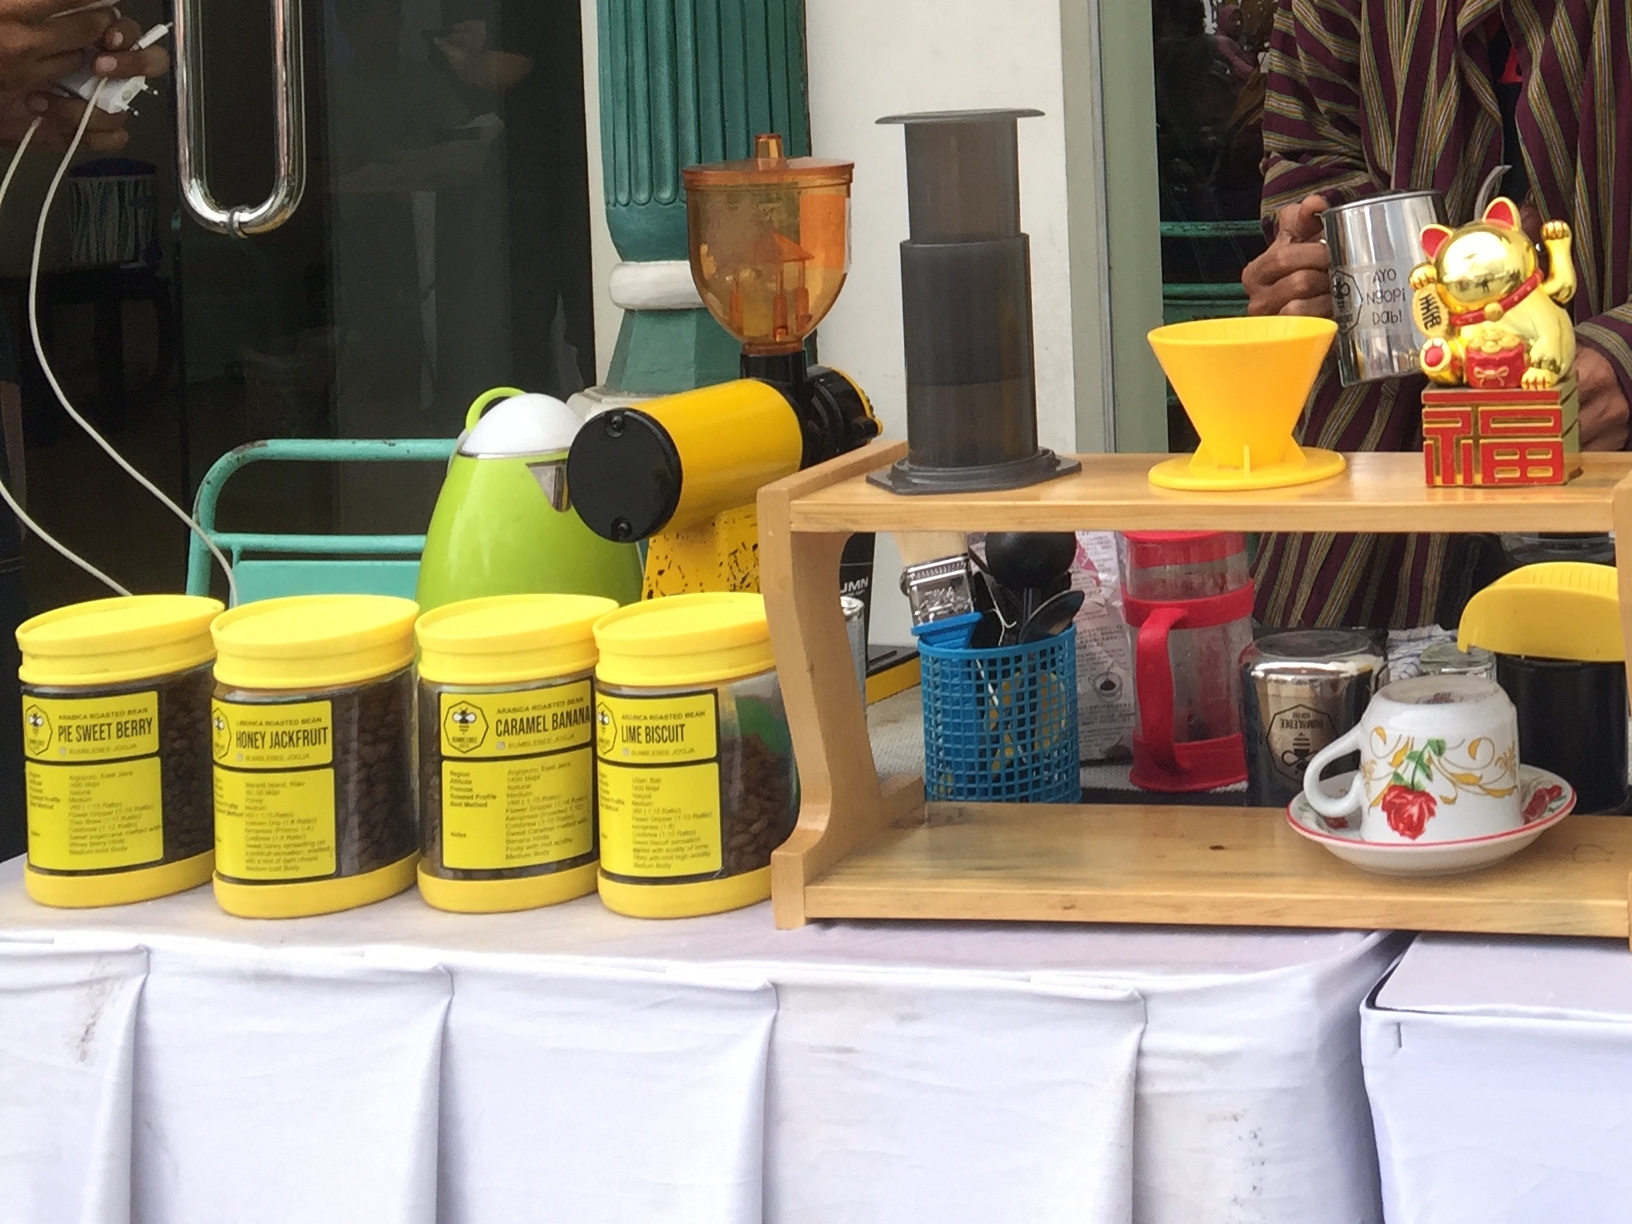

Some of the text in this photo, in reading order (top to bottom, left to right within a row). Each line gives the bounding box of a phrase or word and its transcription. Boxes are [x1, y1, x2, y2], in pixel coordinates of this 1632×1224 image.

[1373, 268, 1397, 283] AYO
[58, 718, 153, 743] PIE SWEET BERRY
[495, 705, 590, 737] CARAMEL BANANA
[236, 726, 328, 749] HONEY JACKFRUIT
[621, 723, 685, 744] LIME BISCUIT
